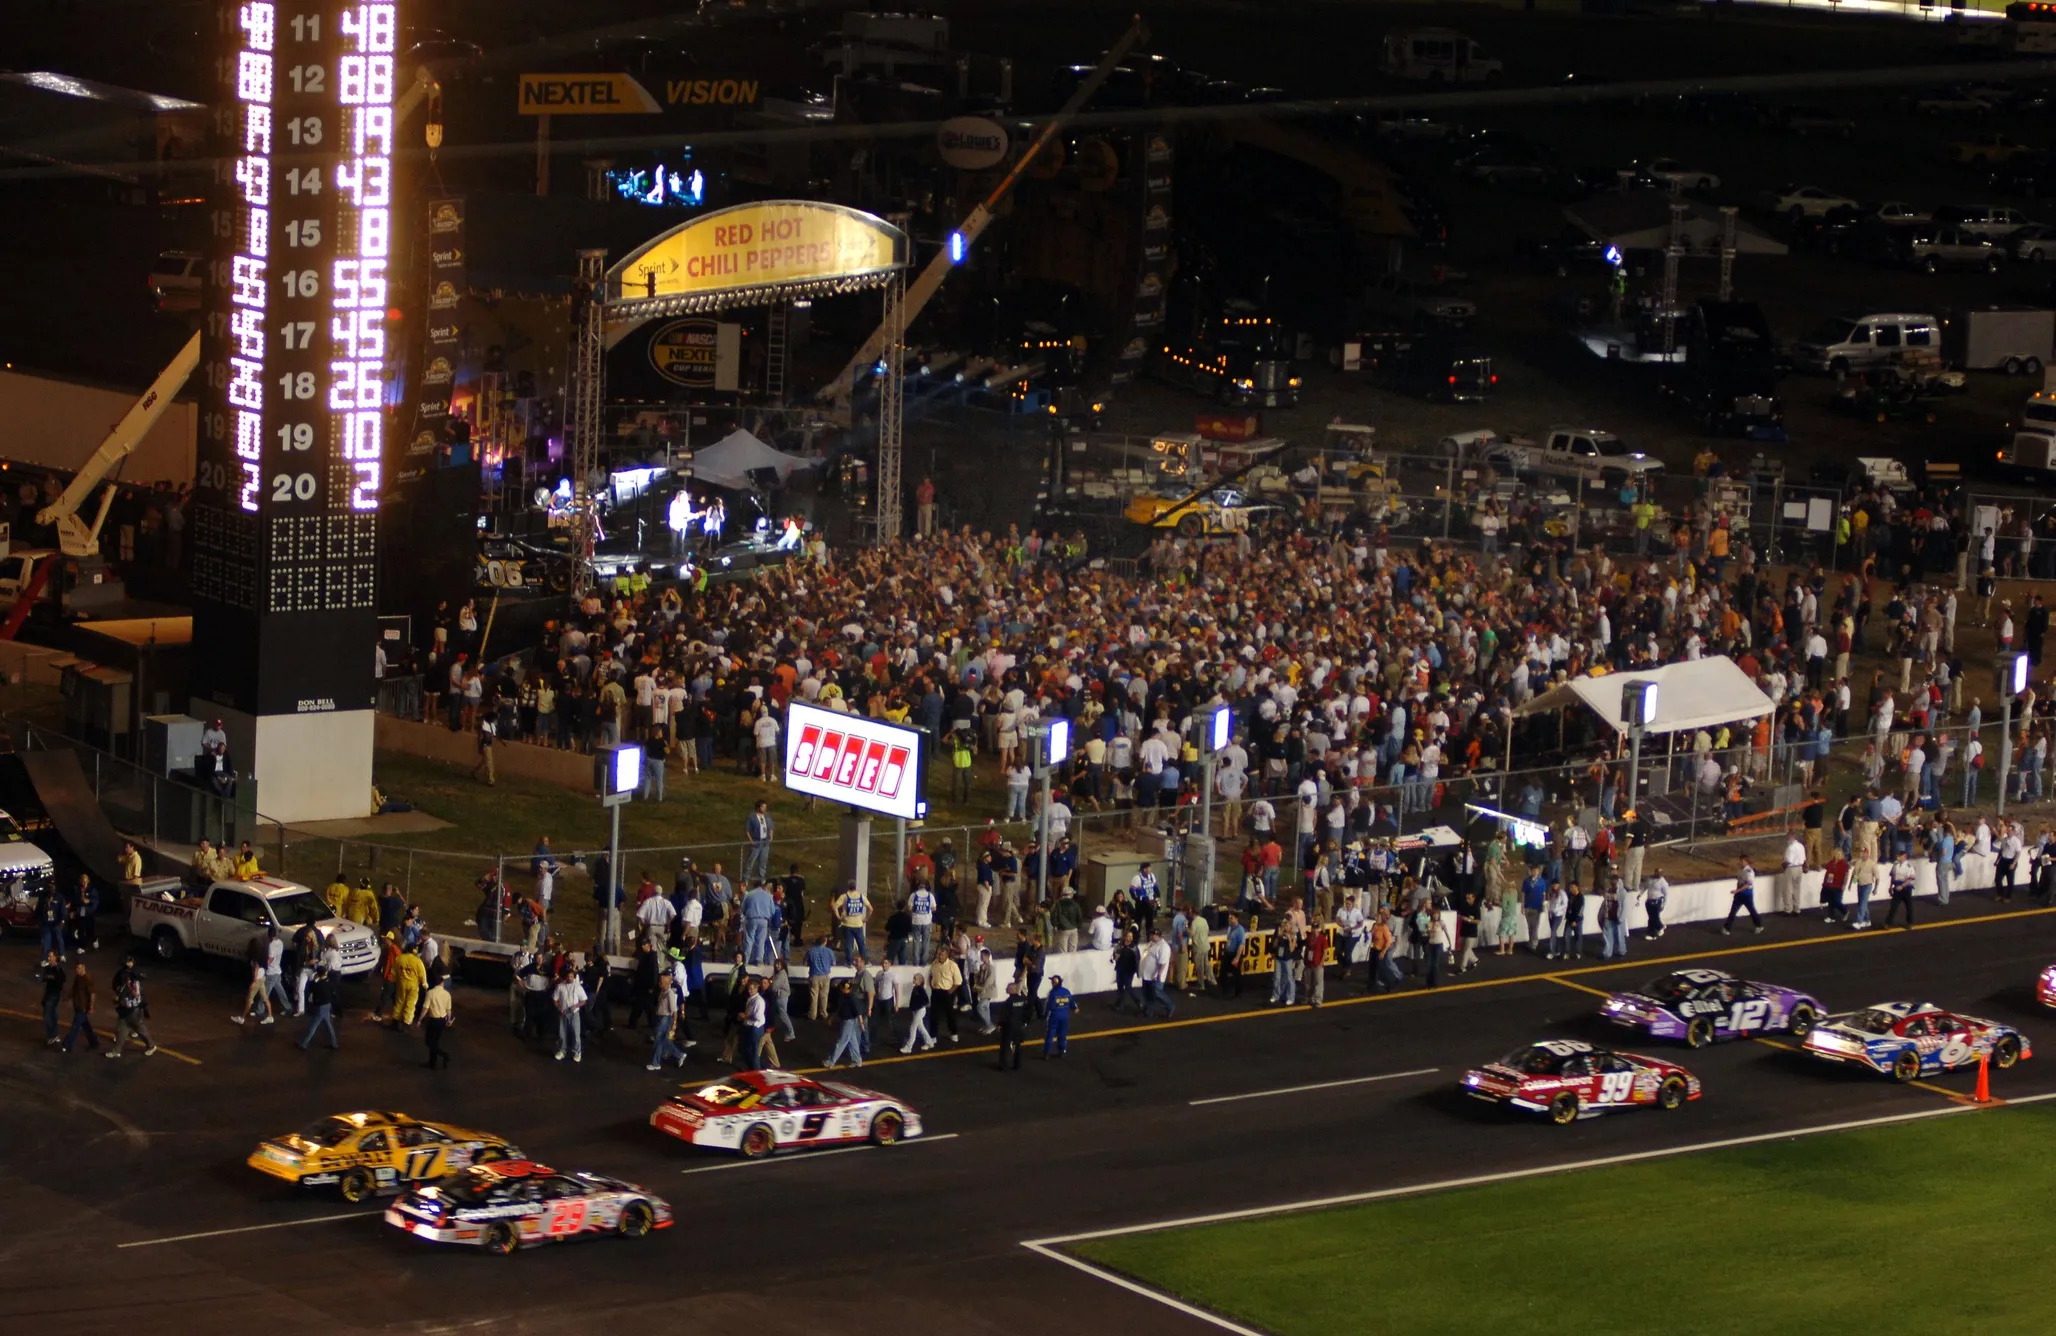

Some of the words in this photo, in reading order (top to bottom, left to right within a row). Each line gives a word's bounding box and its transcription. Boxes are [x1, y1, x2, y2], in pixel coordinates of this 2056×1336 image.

[291, 15, 320, 42] 11
[342, 4, 395, 52] 48
[289, 66, 324, 92] 12
[340, 55, 393, 104] 88
[524, 81, 620, 105] NEXTEL
[667, 80, 758, 104] VISION
[287, 118, 323, 145] 13
[354, 106, 392, 154] 19
[236, 155, 269, 205] 43
[286, 169, 322, 195] 14
[337, 157, 390, 206] 43
[285, 220, 320, 247] 15
[362, 208, 388, 257] 8
[715, 224, 753, 248] RED
[762, 217, 803, 242] HOT
[432, 251, 452, 263] Sprint
[638, 262, 666, 279] Sprint
[687, 252, 738, 278] CHILI
[746, 241, 832, 272] PEPPERS
[282, 270, 319, 297] 16
[333, 259, 387, 307] 55
[281, 322, 316, 349] 17
[331, 310, 384, 357] 45
[430, 328, 449, 339] Sprint
[668, 347, 717, 361] NEXTE
[672, 363, 692, 373] CUP
[279, 372, 316, 400] 18
[329, 361, 383, 410] 26
[420, 401, 440, 413] Sprint
[204, 412, 225, 440] 19
[277, 424, 314, 451] 19
[344, 411, 382, 460] 10
[200, 461, 226, 489] 20
[272, 473, 317, 501] 20
[353, 462, 380, 510] 2
[487, 560, 523, 587] 06
[791, 733, 907, 798] SPEED
[134, 899, 195, 920] TUNDRA
[1728, 1000, 1769, 1031] 12
[1940, 1033, 1968, 1064] 6
[1597, 1071, 1635, 1102] 99
[798, 1112, 829, 1139] 9
[407, 1147, 441, 1180] 17
[550, 1200, 587, 1236] 29
